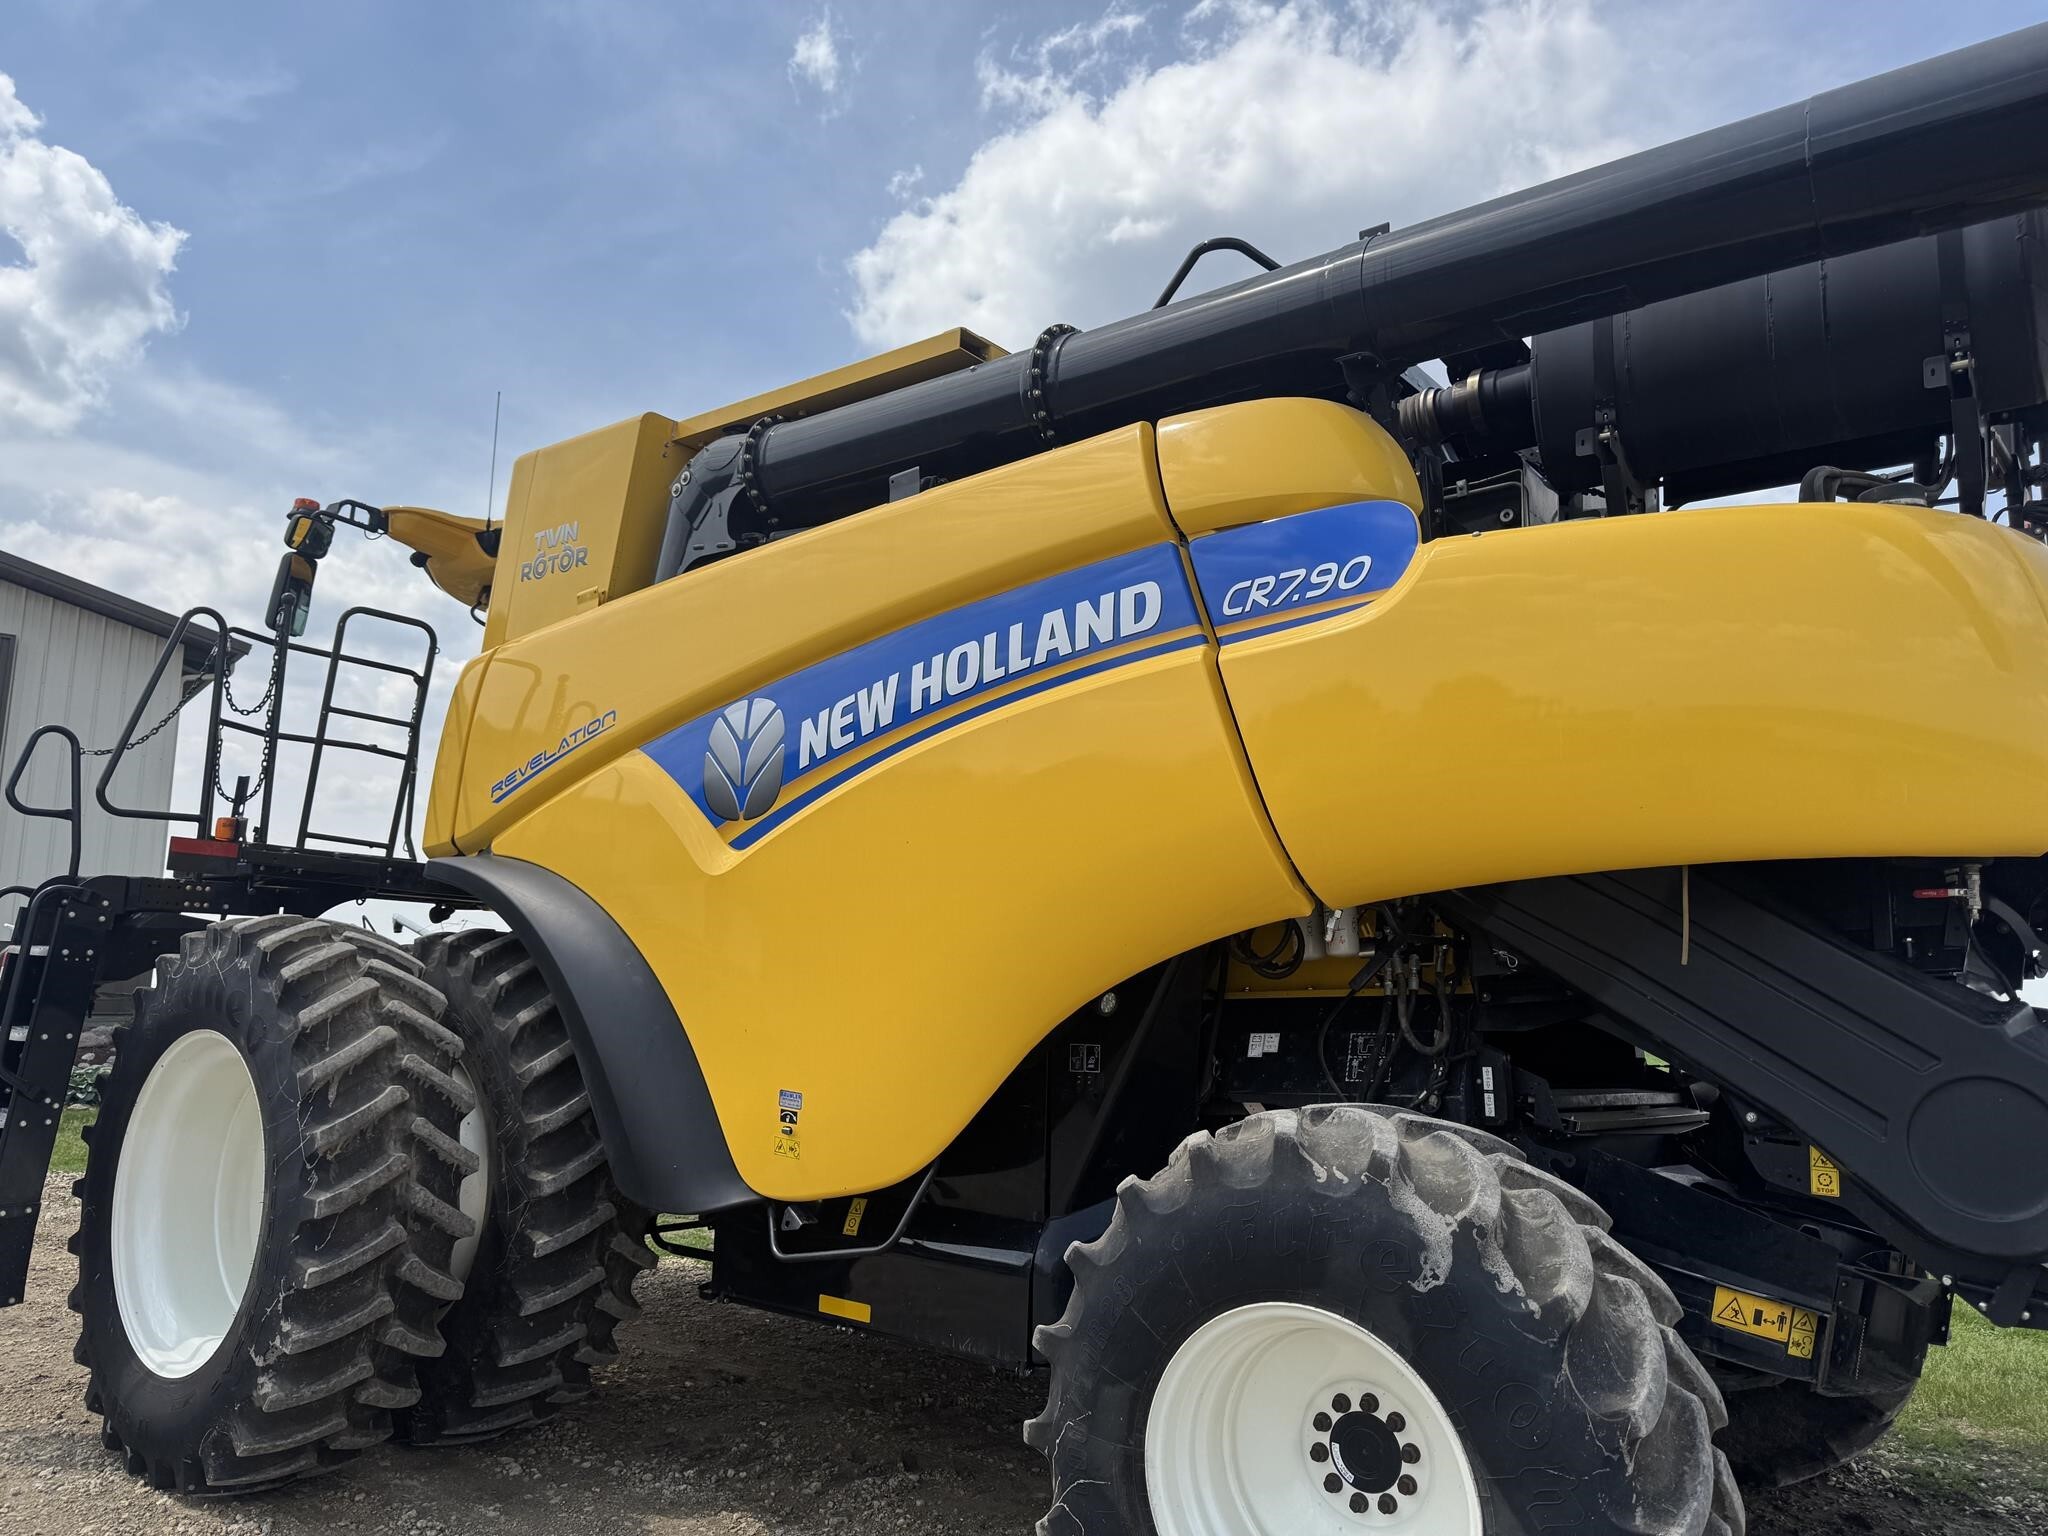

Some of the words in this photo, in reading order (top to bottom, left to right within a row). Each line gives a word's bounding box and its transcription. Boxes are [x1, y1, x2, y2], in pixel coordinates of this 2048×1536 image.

[521, 544, 588, 582] ROTOR
[535, 521, 579, 551] TWIN
[1222, 555, 1372, 617] CR7.90
[799, 672, 900, 770] NEW
[910, 581, 1162, 714] HOLLAND
[490, 710, 616, 799] REVELATION
[1216, 1199, 1585, 1533] Fireston
